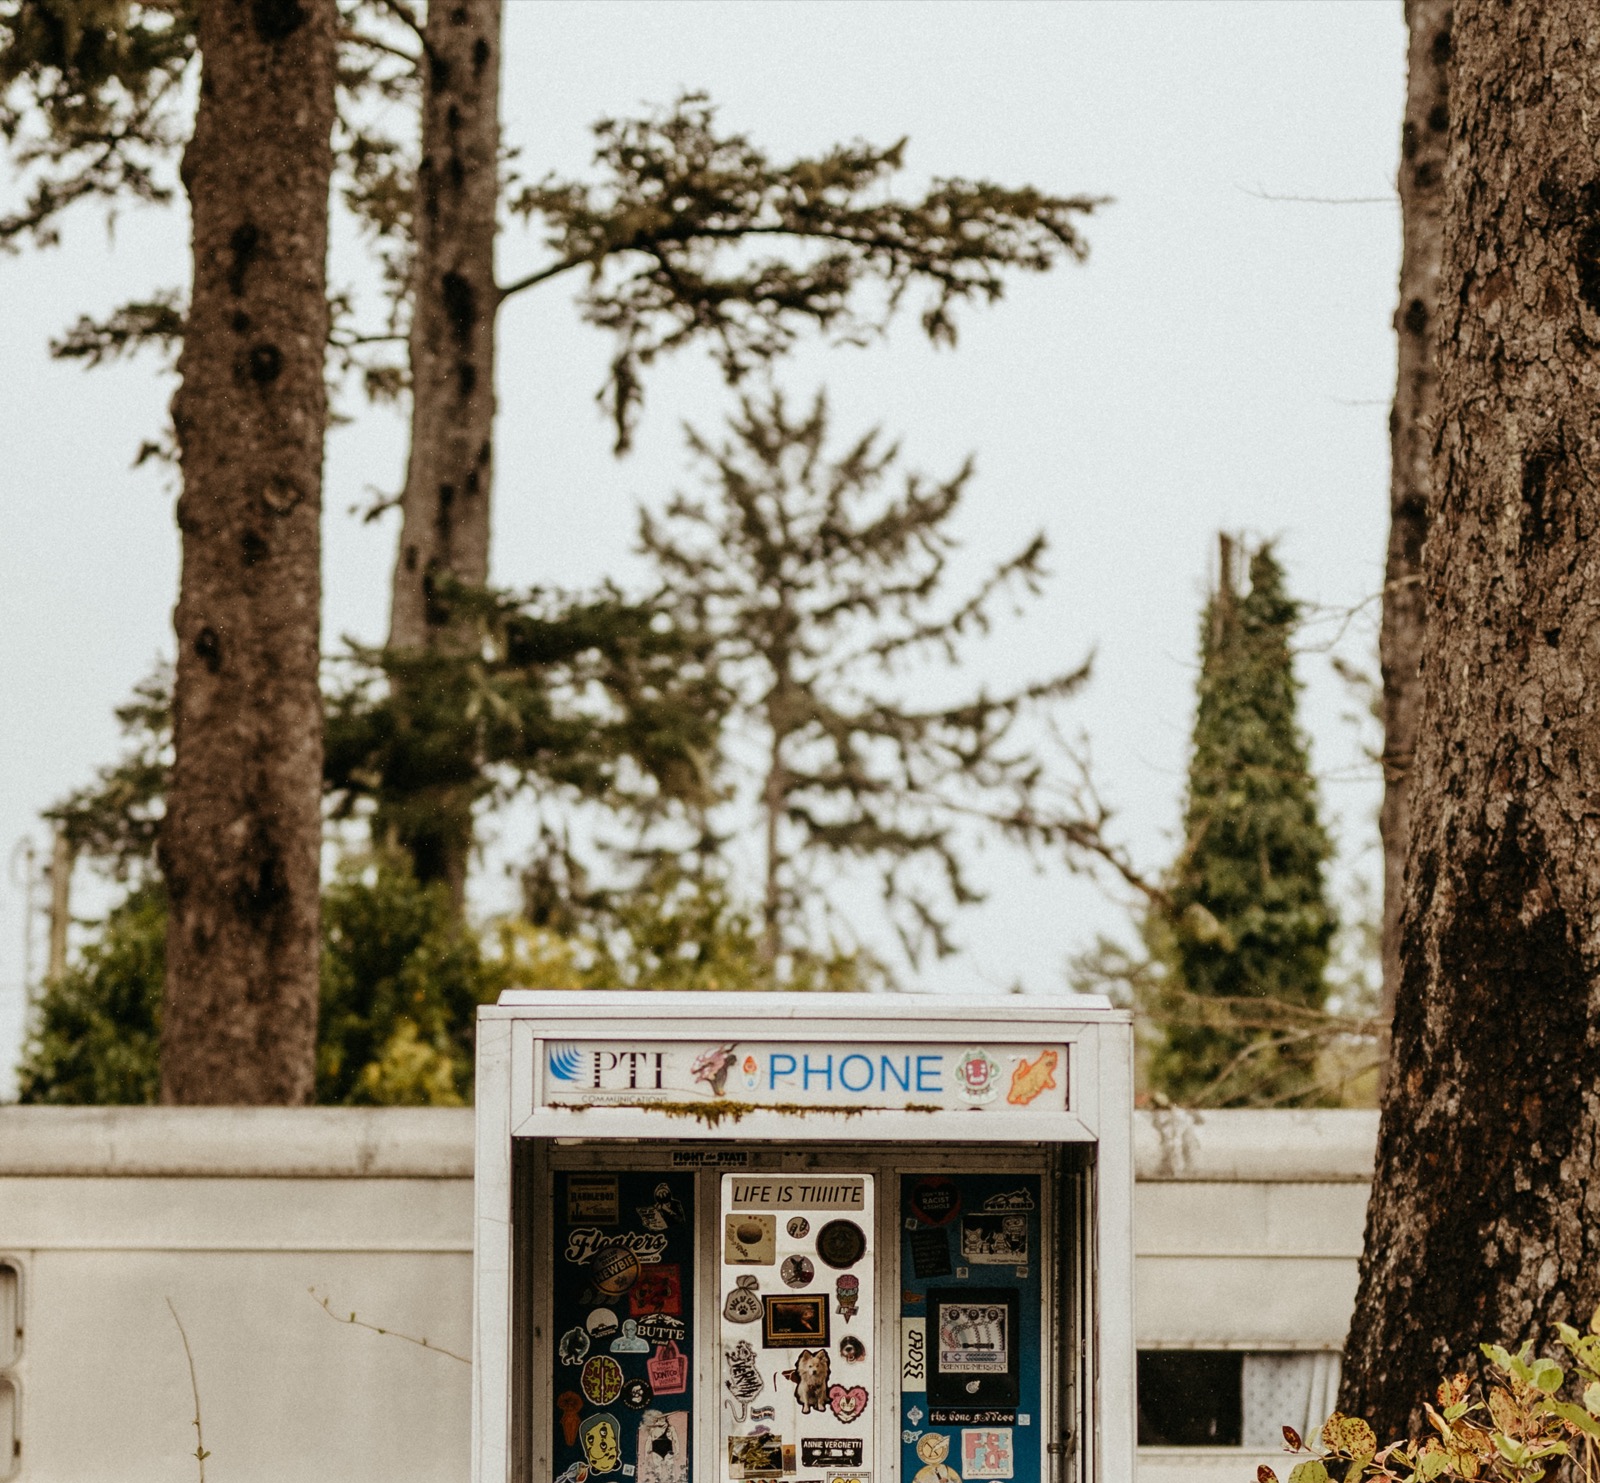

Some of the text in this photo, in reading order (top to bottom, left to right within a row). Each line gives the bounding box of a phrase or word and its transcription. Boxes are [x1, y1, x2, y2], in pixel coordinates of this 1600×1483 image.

[590, 1051, 668, 1089] PTI
[769, 1053, 944, 1092] PHONE
[581, 1094, 668, 1104] COMMUNICATIONS
[673, 1152, 704, 1161] FIGHT
[717, 1152, 748, 1161] STATE
[734, 1186, 772, 1203] LIFE
[777, 1186, 794, 1203] IS
[597, 1255, 637, 1282] NEWBIE
[739, 1295, 747, 1303] OF
[637, 1325, 685, 1341] BUTTE
[931, 1411, 946, 1421] the
[803, 1441, 823, 1449] ANNIE
